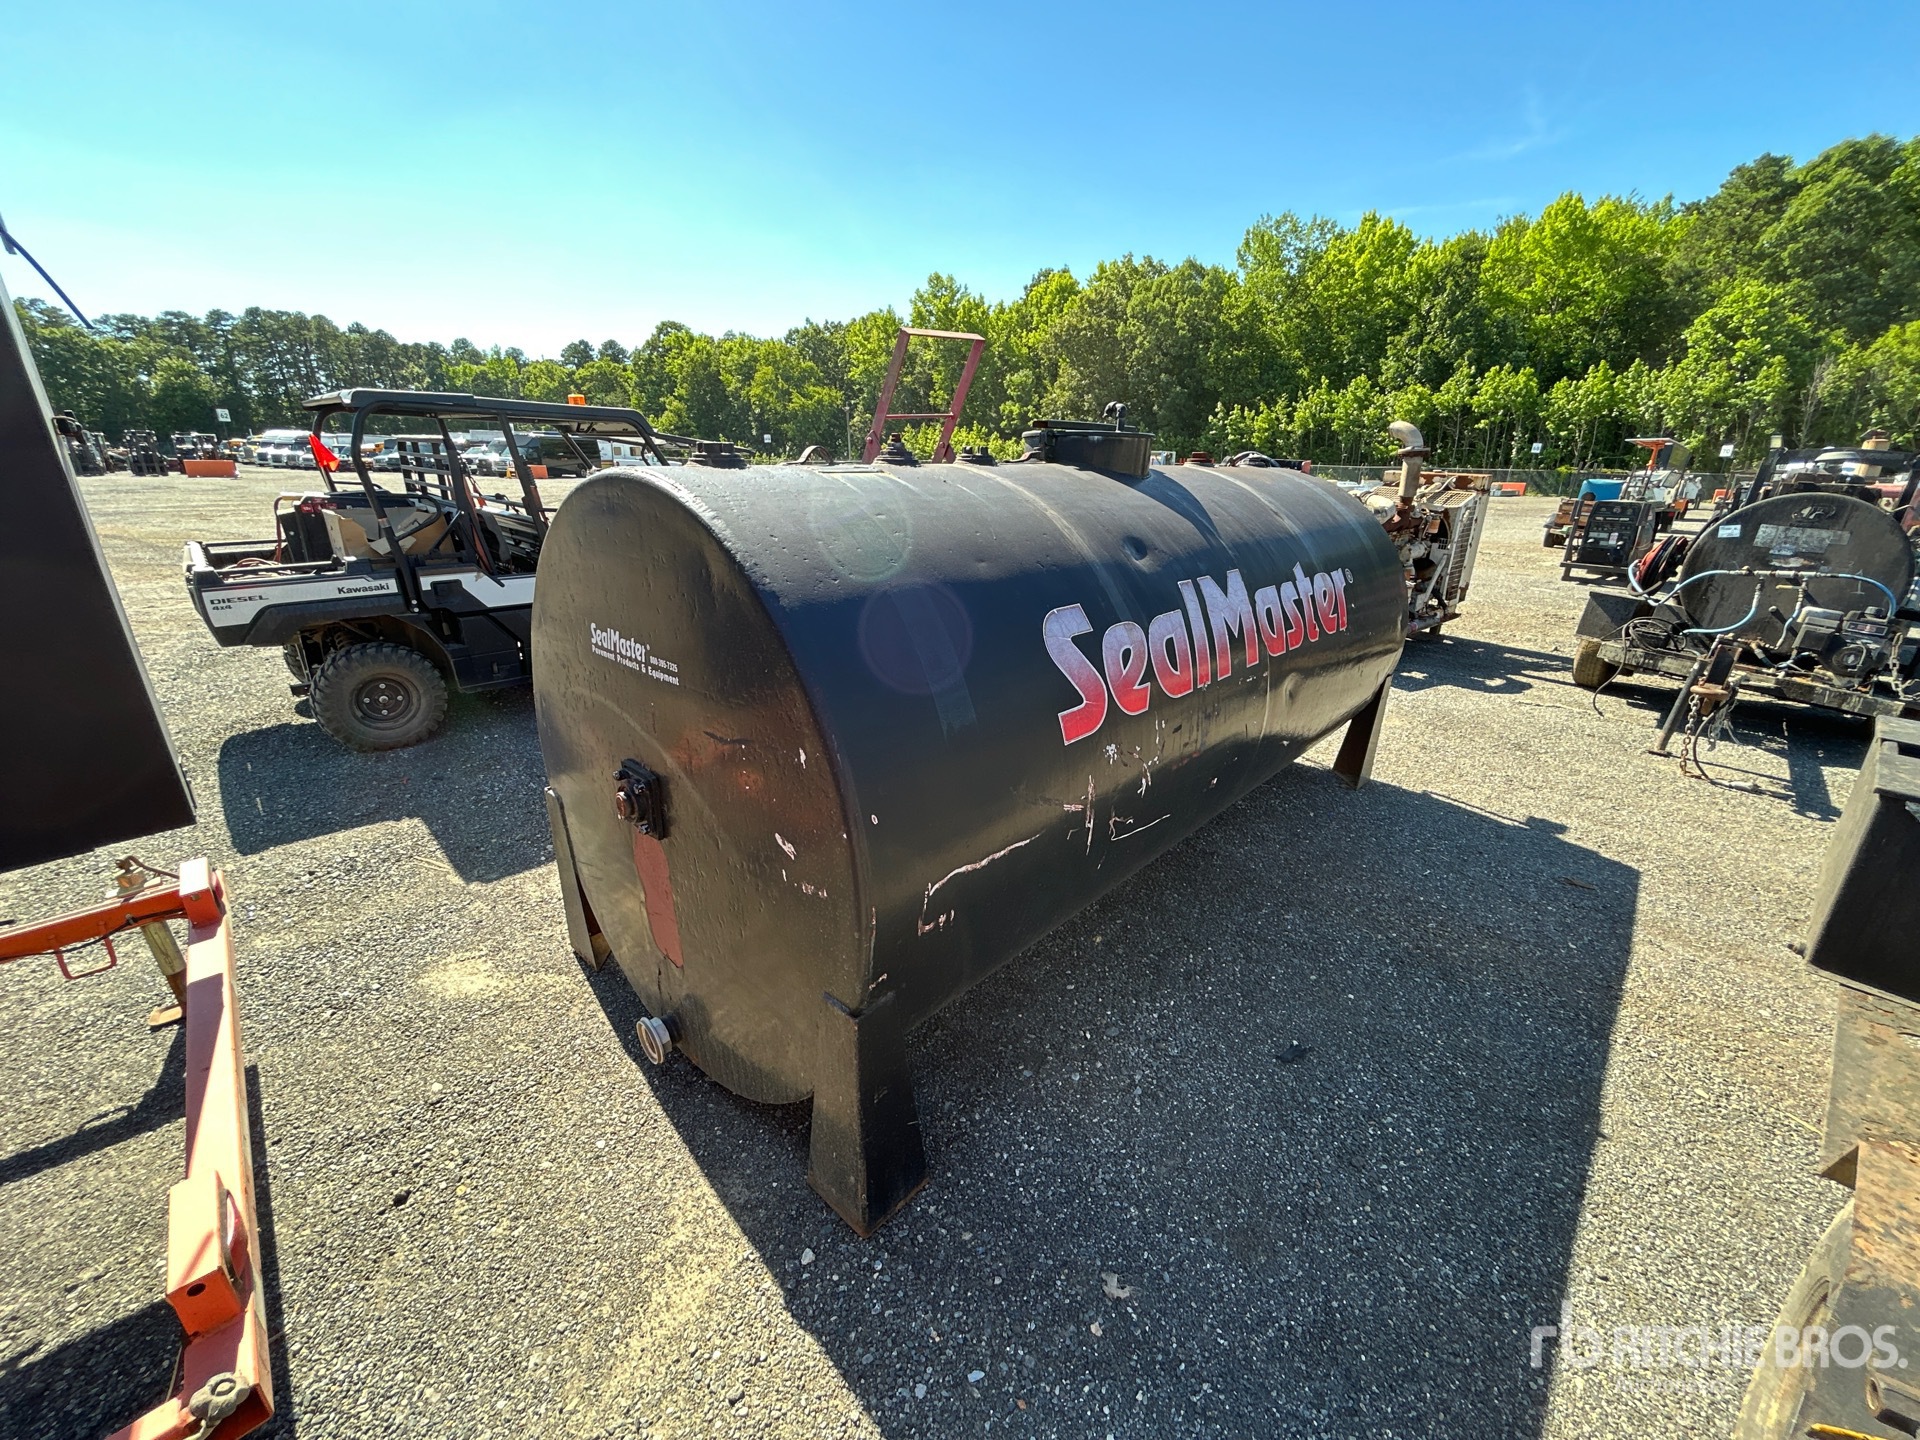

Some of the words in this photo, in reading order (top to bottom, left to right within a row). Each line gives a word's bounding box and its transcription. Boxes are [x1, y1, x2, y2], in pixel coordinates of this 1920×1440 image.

[209, 594, 270, 605] DIESEL
[337, 582, 390, 595] Kawasaki
[590, 622, 646, 662] SealMaster
[1043, 561, 1348, 745] SealMaster
[591, 644, 616, 661] Pavement
[616, 654, 640, 671] Products
[641, 663, 647, 673] &
[647, 666, 680, 686] Equipment
